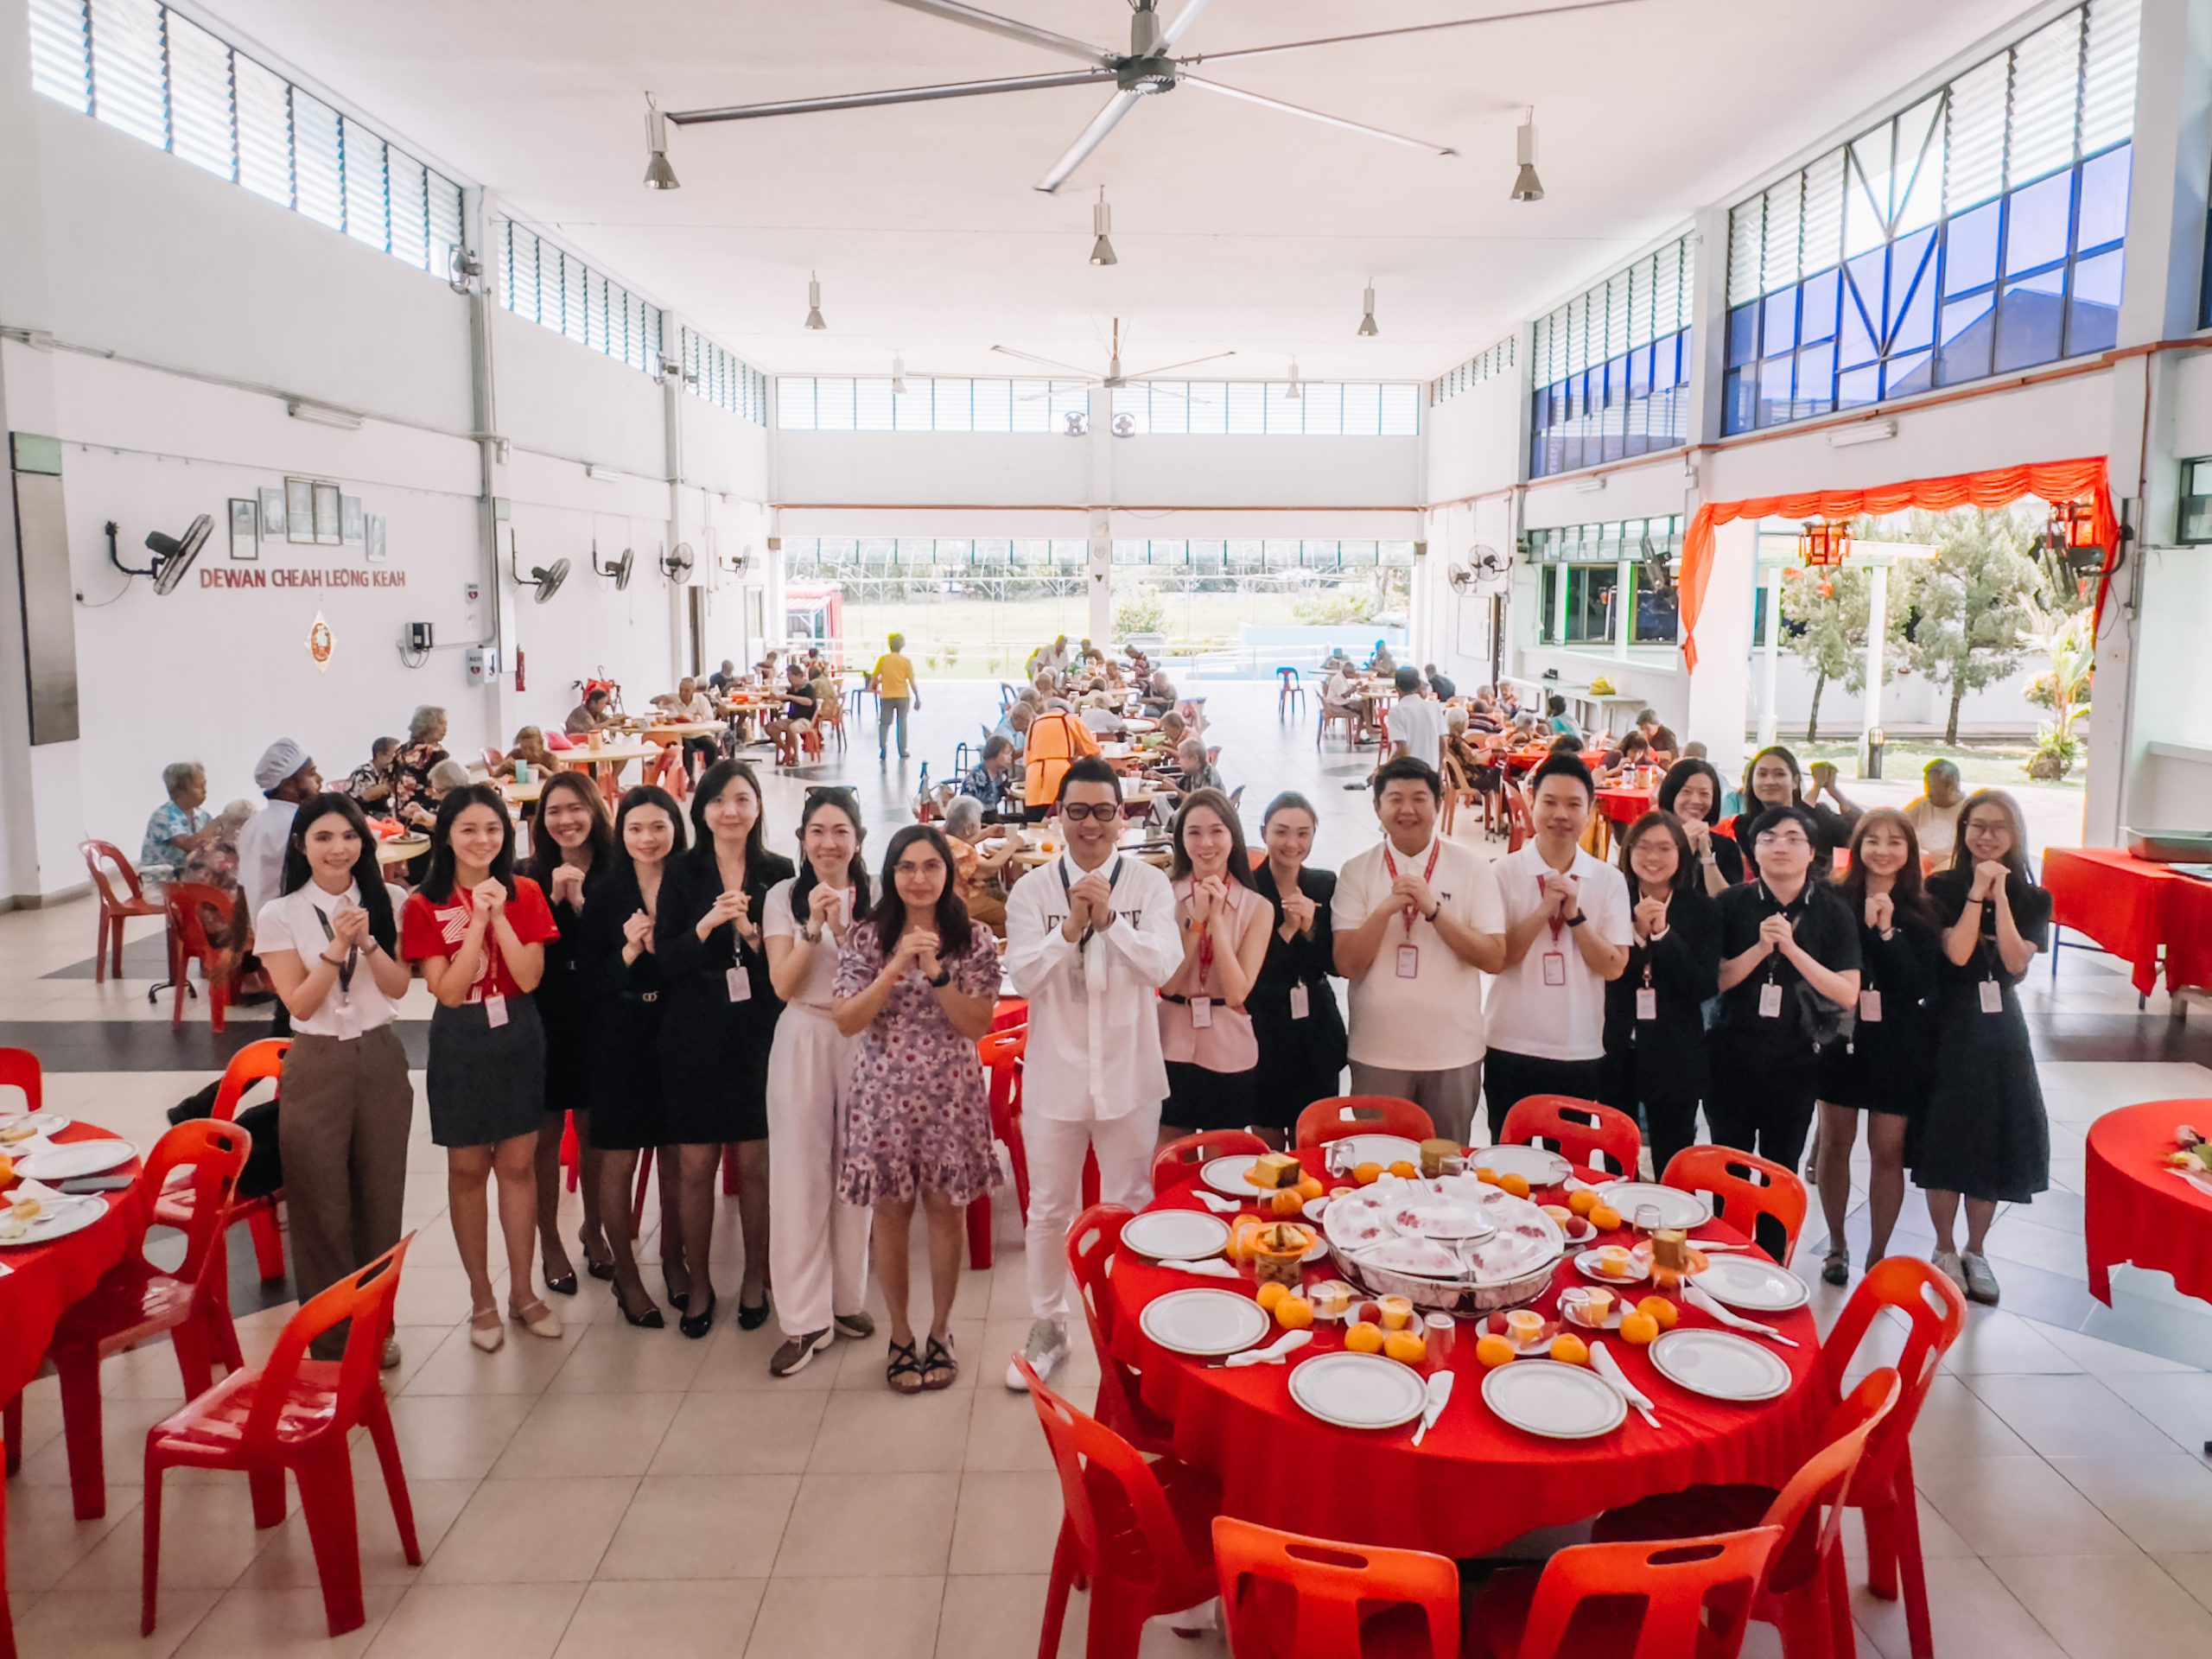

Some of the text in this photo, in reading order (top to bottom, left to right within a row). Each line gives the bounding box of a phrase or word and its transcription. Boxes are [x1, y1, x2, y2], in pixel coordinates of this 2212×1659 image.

[200, 568, 406, 588] DEWAN CHEAH LEONG KEAH
